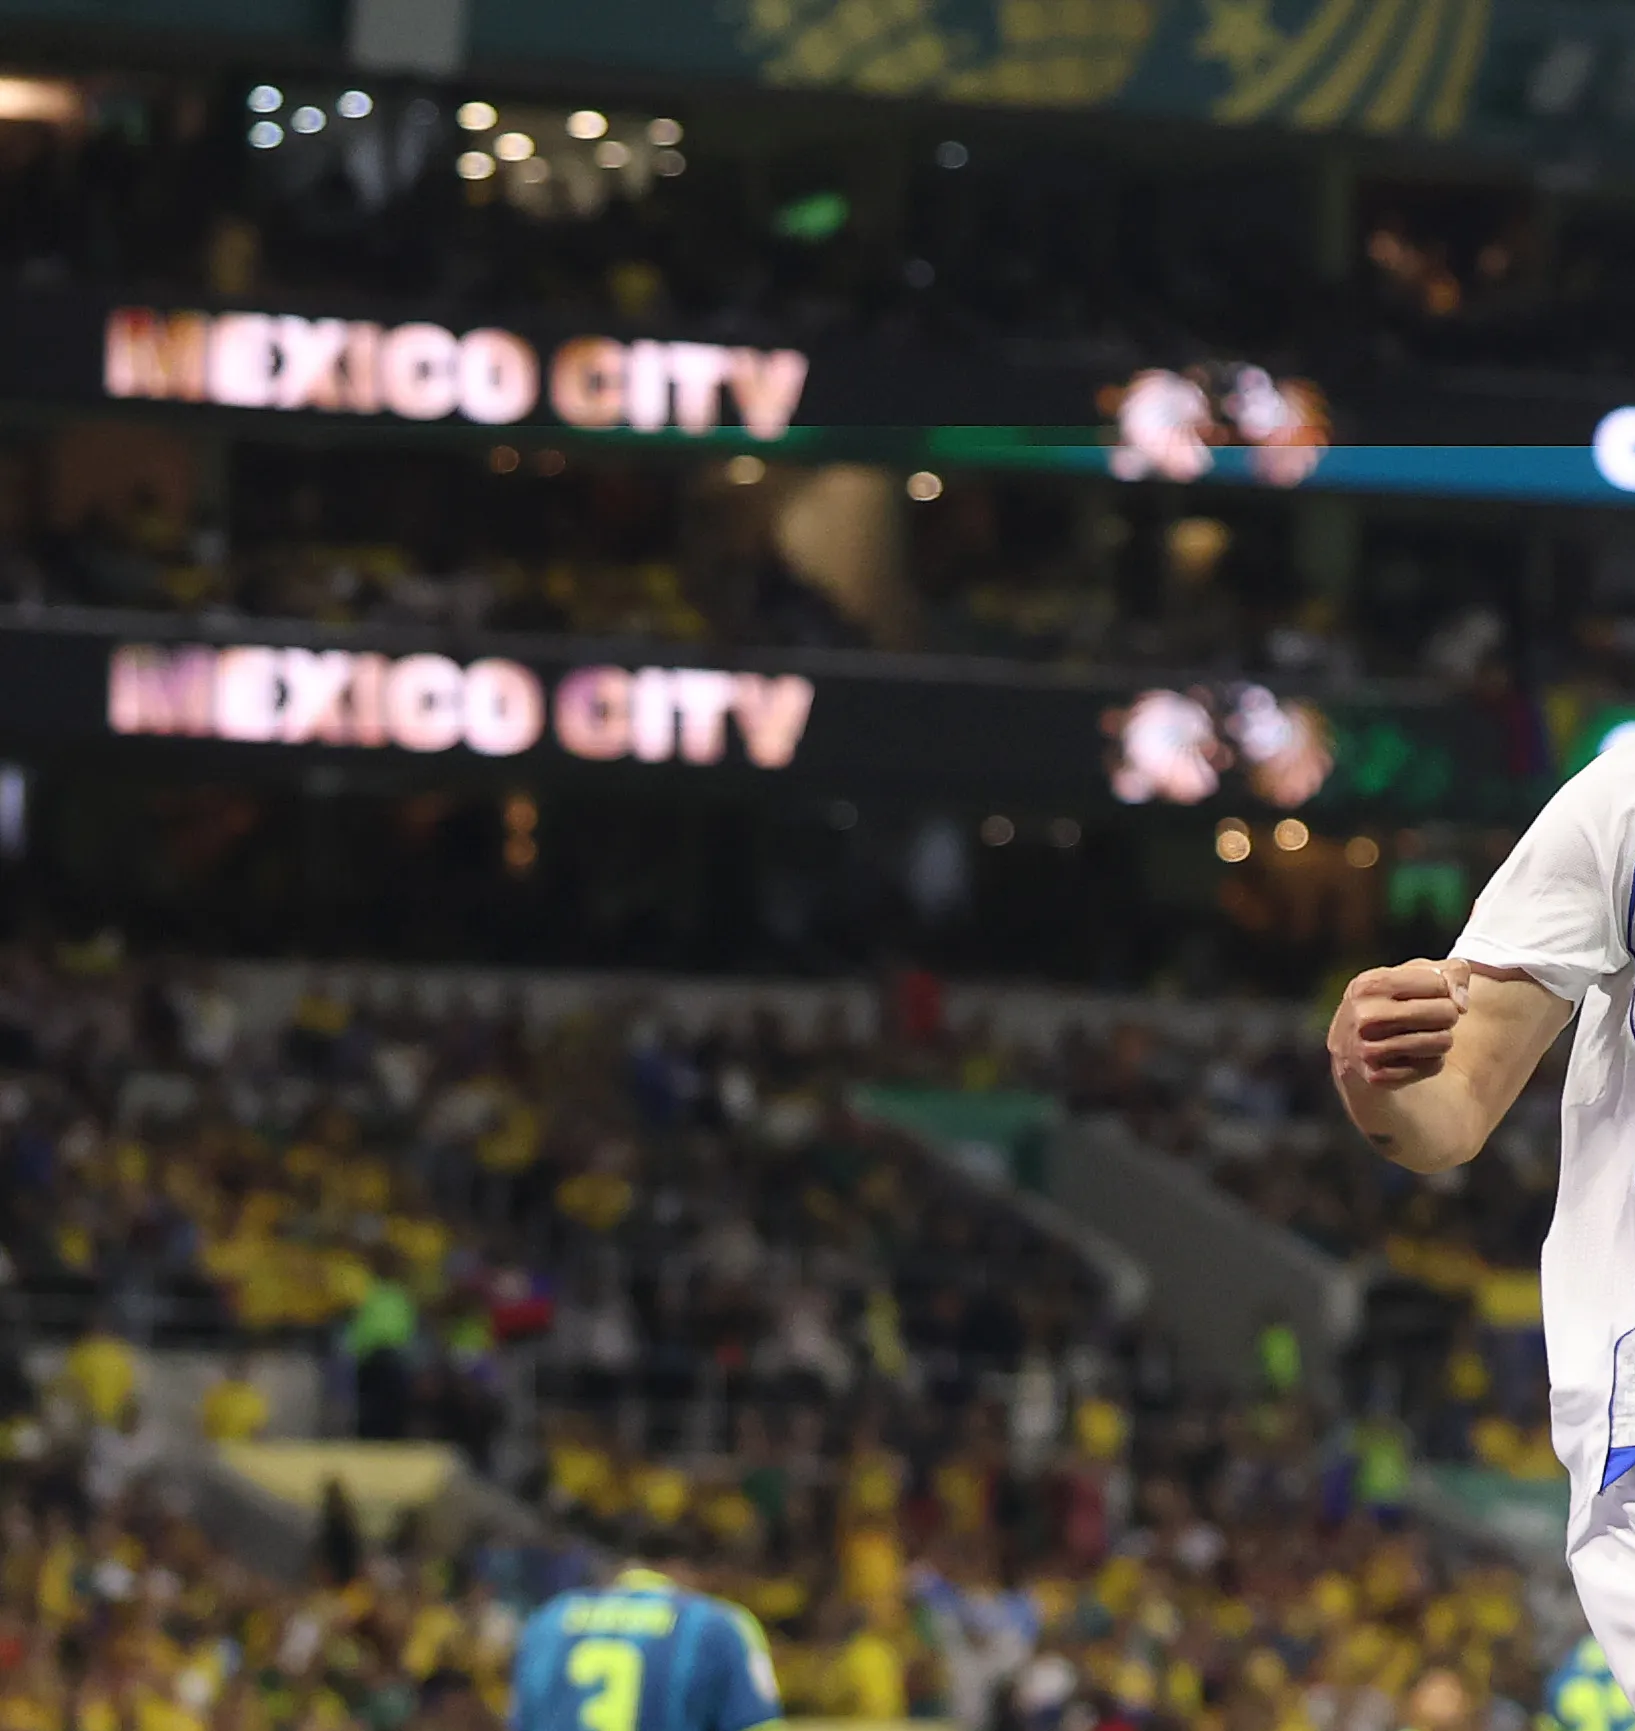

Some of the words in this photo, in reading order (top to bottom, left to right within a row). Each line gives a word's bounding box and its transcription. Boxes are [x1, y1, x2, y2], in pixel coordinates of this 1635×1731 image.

[106, 310, 537, 424] MEXICO
[551, 337, 807, 440] CITY
[109, 644, 543, 756] MEXICO
[556, 664, 813, 768] CITY
